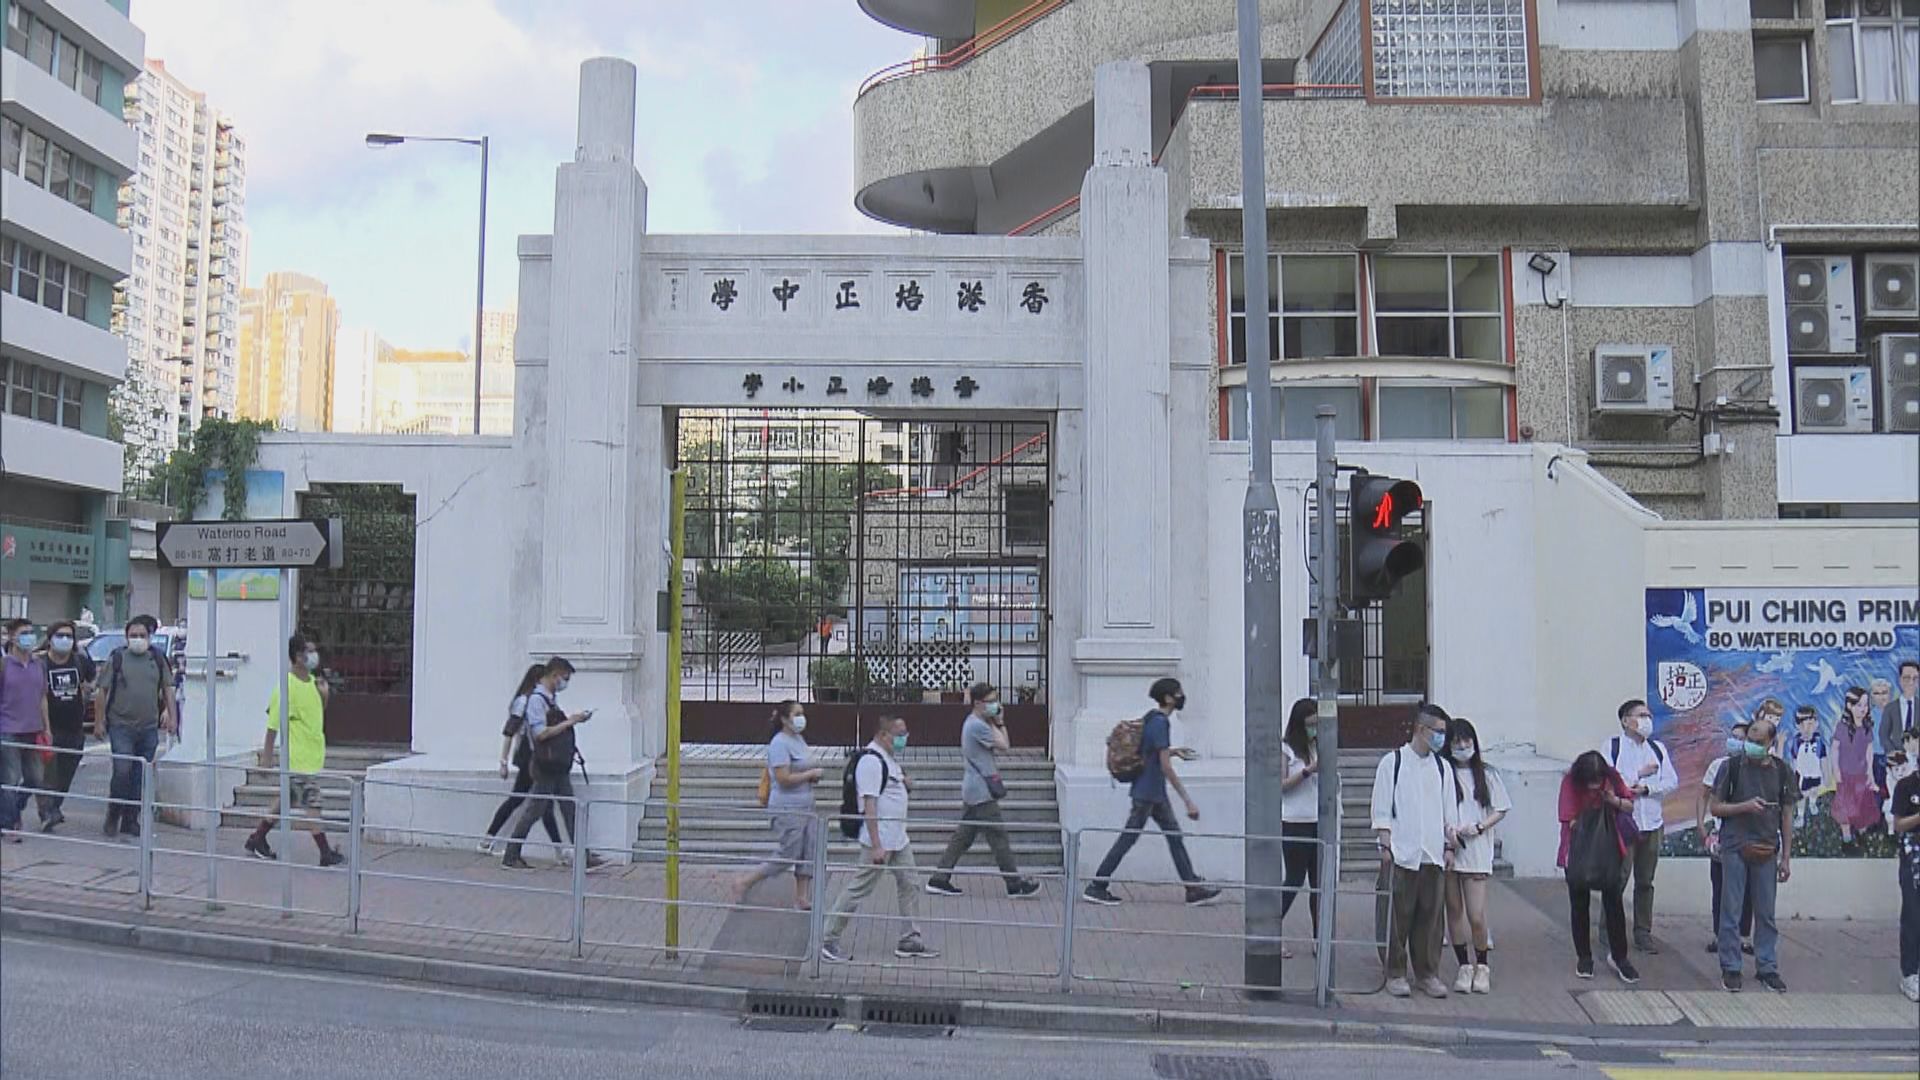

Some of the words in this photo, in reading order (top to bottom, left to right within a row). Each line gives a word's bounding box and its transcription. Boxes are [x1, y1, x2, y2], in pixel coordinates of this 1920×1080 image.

[198, 526, 251, 540] Waterloo
[254, 526, 287, 539] Road
[208, 546, 275, 563] 窩打老道
[1708, 599, 1750, 624] PUI
[1762, 599, 1847, 624] CHING
[1708, 631, 1733, 648] 80
[1737, 631, 1837, 648] WATERLOO
[1843, 631, 1893, 648] ROAD
